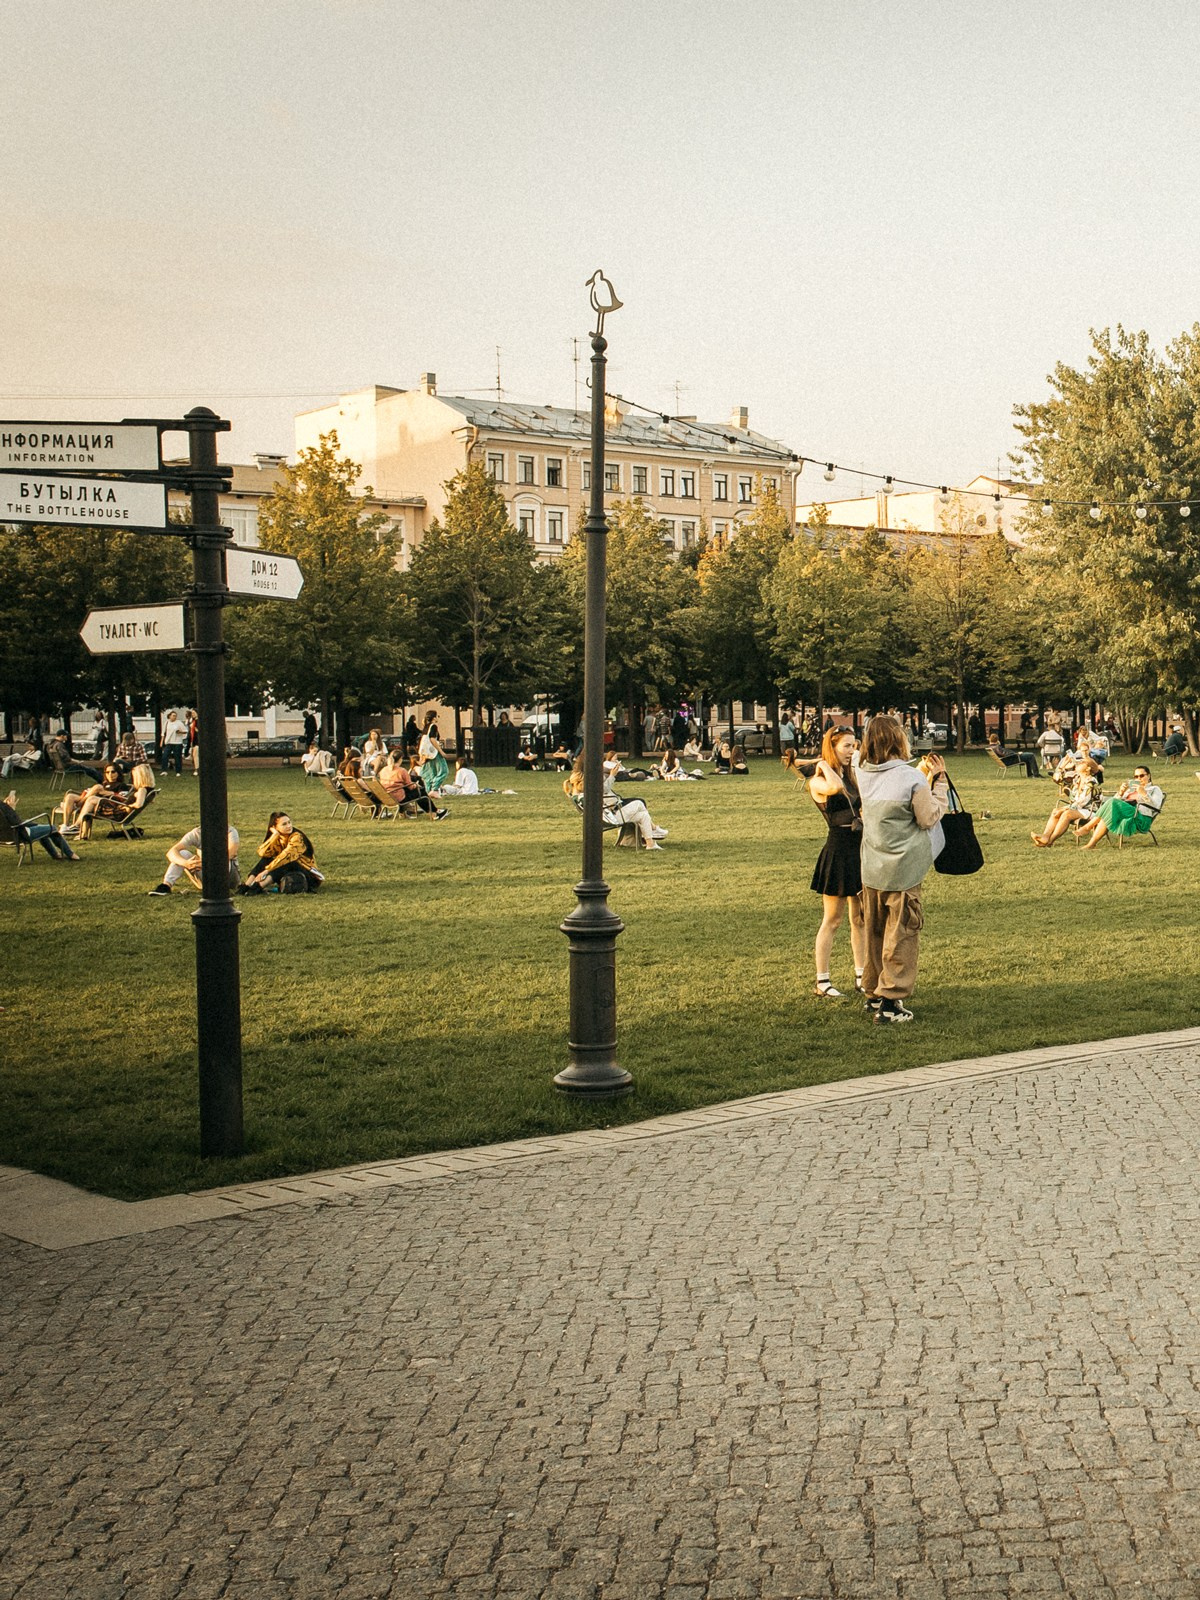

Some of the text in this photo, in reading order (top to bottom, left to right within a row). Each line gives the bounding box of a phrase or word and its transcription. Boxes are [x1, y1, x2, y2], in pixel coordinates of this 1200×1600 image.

[1, 432, 114, 451] НФОРМАЦИЯ
[8, 453, 95, 463] INFORMATION
[20, 482, 117, 503] БУТЫЛКА
[7, 503, 129, 519] THE BOTTLEHOUSE
[251, 560, 278, 576] ДОМ 12
[253, 579, 278, 590] HOUSE 12
[99, 621, 159, 639] ТУАЛЕТ WC
